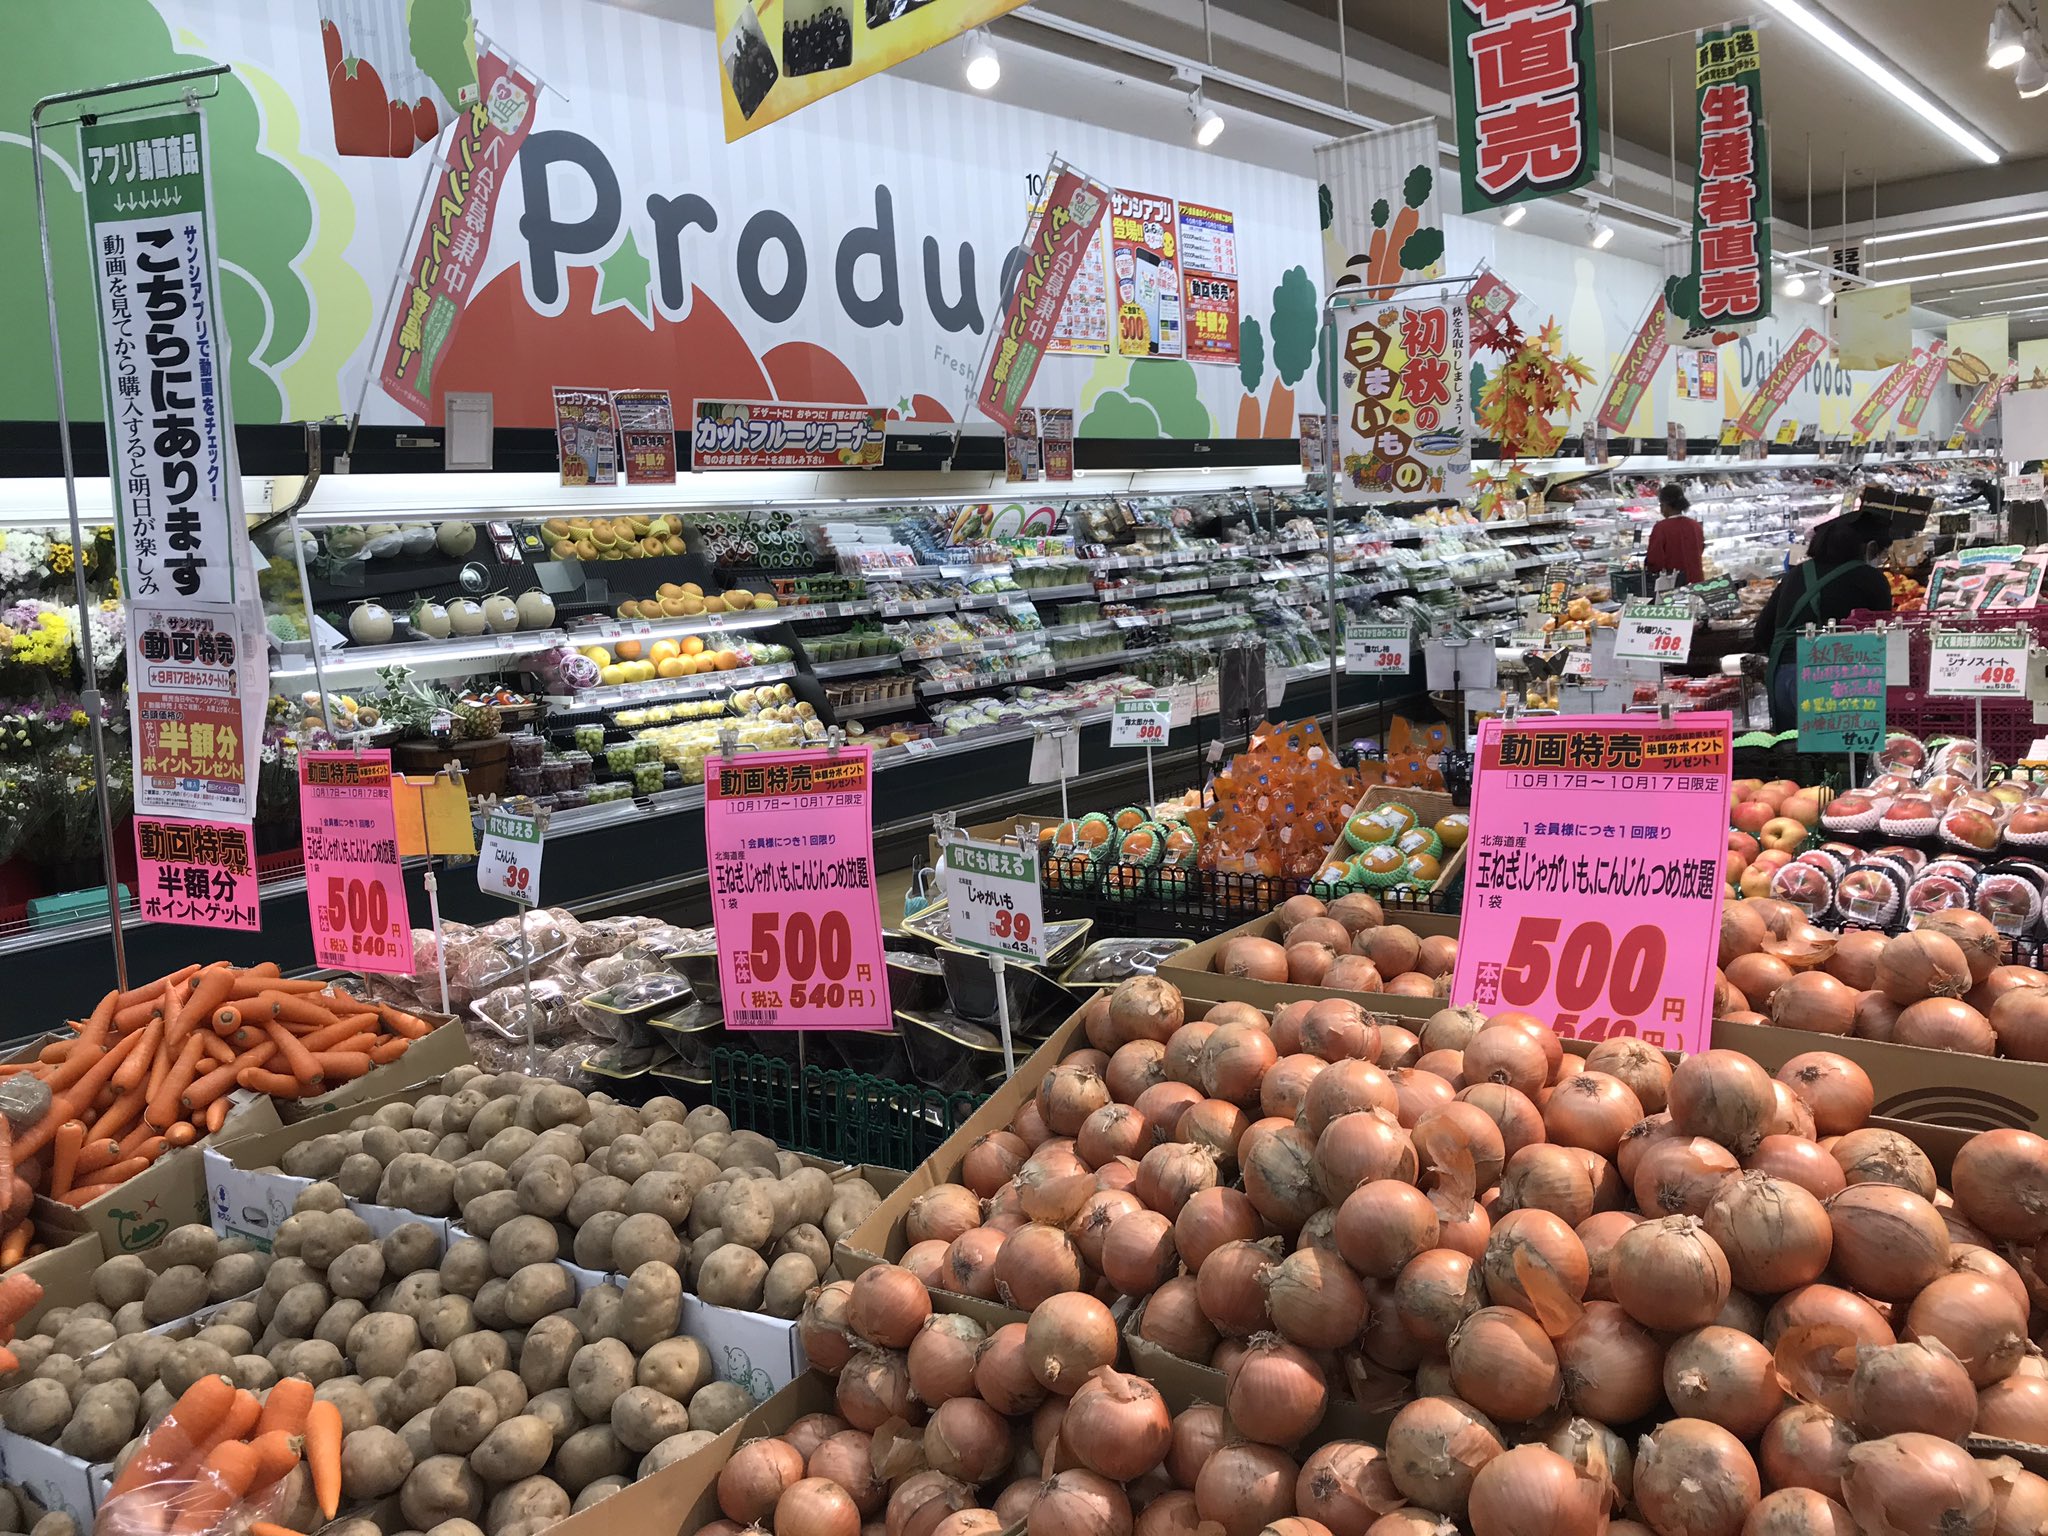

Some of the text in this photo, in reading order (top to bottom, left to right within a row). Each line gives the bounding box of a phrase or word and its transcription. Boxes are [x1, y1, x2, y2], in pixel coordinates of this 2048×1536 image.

[1468, 0, 1581, 194] 直売
[88, 132, 200, 185] アプリ動画商品
[1112, 193, 1171, 223] サンシアプリ
[1699, 84, 1760, 319] 生産者直売
[1120, 315, 1143, 340] 300
[184, 225, 219, 502] サンシアプリで動画をチェック!
[934, 344, 974, 382] Fresh
[1400, 306, 1451, 430] 初秋の
[1452, 306, 1465, 425] 秋を先取りしましょう!
[103, 234, 160, 595] 動画を見てから購入すると明日が楽しみ
[136, 228, 207, 597] こちらにあります
[752, 407, 793, 419] デザートに!
[796, 408, 828, 420] おやつに!
[1350, 330, 1423, 486] うまいもの
[695, 417, 884, 455] カットフルーツコーナー
[143, 631, 233, 665] 動画特売
[1654, 635, 1682, 650] 198
[1379, 653, 1402, 666] 398
[1948, 657, 2009, 666] シナノスイート
[1980, 667, 2015, 683] 498
[141, 709, 184, 720] 店頭価格の
[158, 721, 238, 760] 半額分
[1140, 725, 1162, 738] 980
[1498, 731, 1644, 769] 動画特売
[1646, 740, 1722, 756] 半額分ポイント
[1663, 754, 1719, 769] プレゼント!
[143, 755, 244, 780] ポイントプレゼント!
[308, 761, 359, 784] 動画特売
[720, 764, 812, 796] 動画特売
[814, 764, 863, 780] 半額分ポイント
[826, 775, 862, 790] プレゼント!
[490, 817, 533, 839] 何でも使える
[740, 834, 836, 849] 1会員様につき1回限り
[1481, 834, 1527, 848] 北海道産
[1523, 822, 1672, 840] 1会員様につき1回限り
[139, 822, 249, 866] 動画特売
[495, 849, 518, 865] にんじん
[715, 851, 746, 861] 北海道産
[229, 864, 253, 877] を見て
[954, 847, 1025, 876] 何でも使える
[1475, 850, 1716, 900] 玉ねぎ、じゃがいも、にんじんつめ放題
[157, 865, 237, 902] 半額分
[716, 856, 869, 895] 玉ねぎ、じゃがいも、にんじんつめ放題
[145, 897, 257, 926] ポイントゲット!!
[720, 898, 738, 909] 1袋
[967, 886, 1014, 911] じゃがいも
[1477, 894, 1503, 909] 1袋
[734, 952, 751, 984] 本体
[1474, 962, 1500, 1005] 本体
